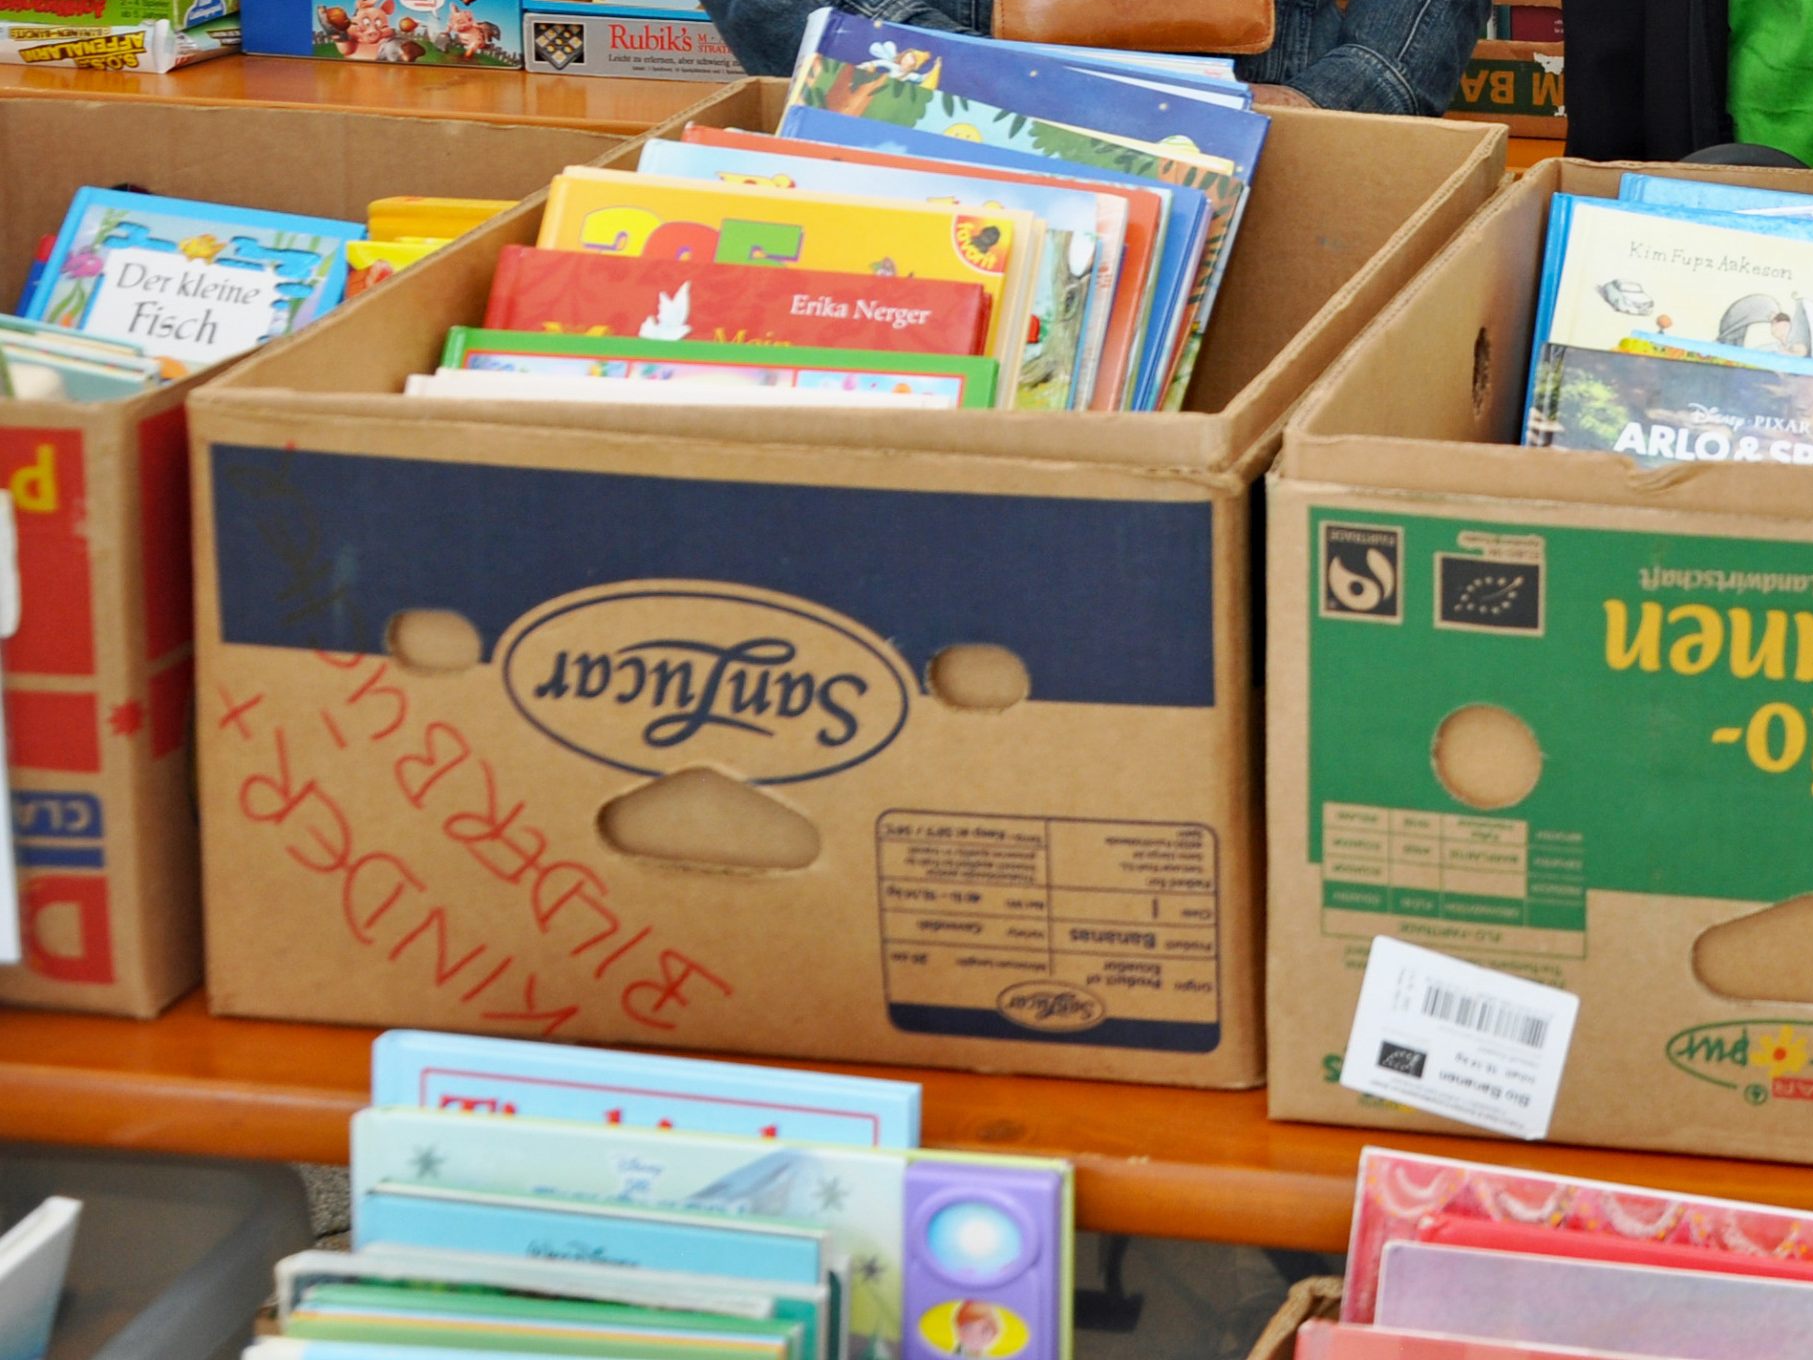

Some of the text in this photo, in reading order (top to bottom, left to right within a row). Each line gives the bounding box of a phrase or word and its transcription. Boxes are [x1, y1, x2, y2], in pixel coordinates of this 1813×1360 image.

[19, 31, 146, 63] AFFENALARM
[608, 24, 693, 52] Rubik's
[609, 54, 631, 62] Leicht
[1629, 241, 1793, 281] Kim Fupz Aakeson
[116, 260, 262, 307] Der kleine
[126, 300, 221, 346] Fisch
[790, 293, 932, 329] Erika Nerger
[1688, 403, 1812, 436] Disney PIXAR
[1613, 422, 1731, 461] ARLO
[1734, 436, 1763, 462] &
[1328, 530, 1395, 546] FAIRTRADE
[532, 638, 868, 748] SanLucar
[239, 727, 578, 1033] KINDER
[1069, 928, 1156, 949] Bananas
[1102, 961, 1161, 976] Ecuador
[1106, 975, 1162, 990] Product
[1675, 1028, 1750, 1067] pur
[1438, 1070, 1502, 1099] Bananen
[1505, 1089, 1530, 1108] Bio
